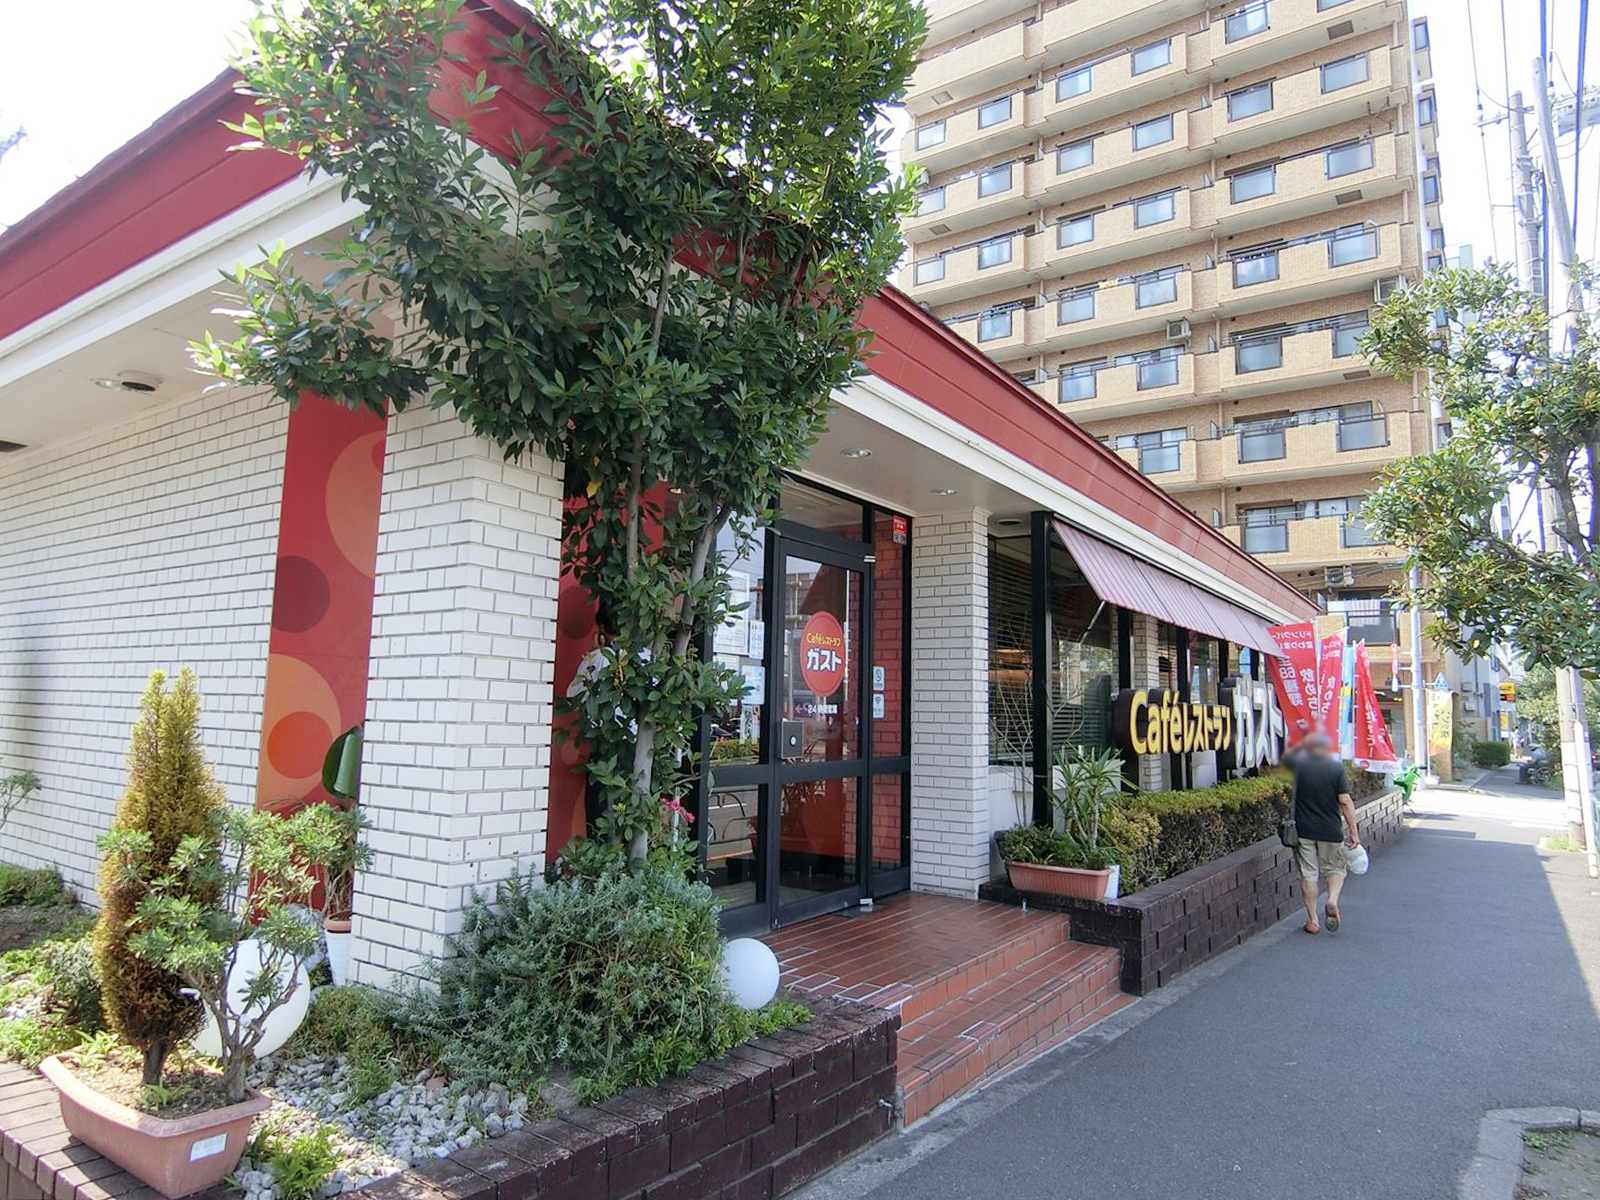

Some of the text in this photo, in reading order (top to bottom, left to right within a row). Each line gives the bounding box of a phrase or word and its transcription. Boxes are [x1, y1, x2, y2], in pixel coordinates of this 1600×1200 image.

[806, 632, 841, 647] Caféレストラン
[806, 647, 843, 672] ガスト
[1130, 689, 1231, 755] Caféレストラン
[1232, 675, 1284, 769] ガスト
